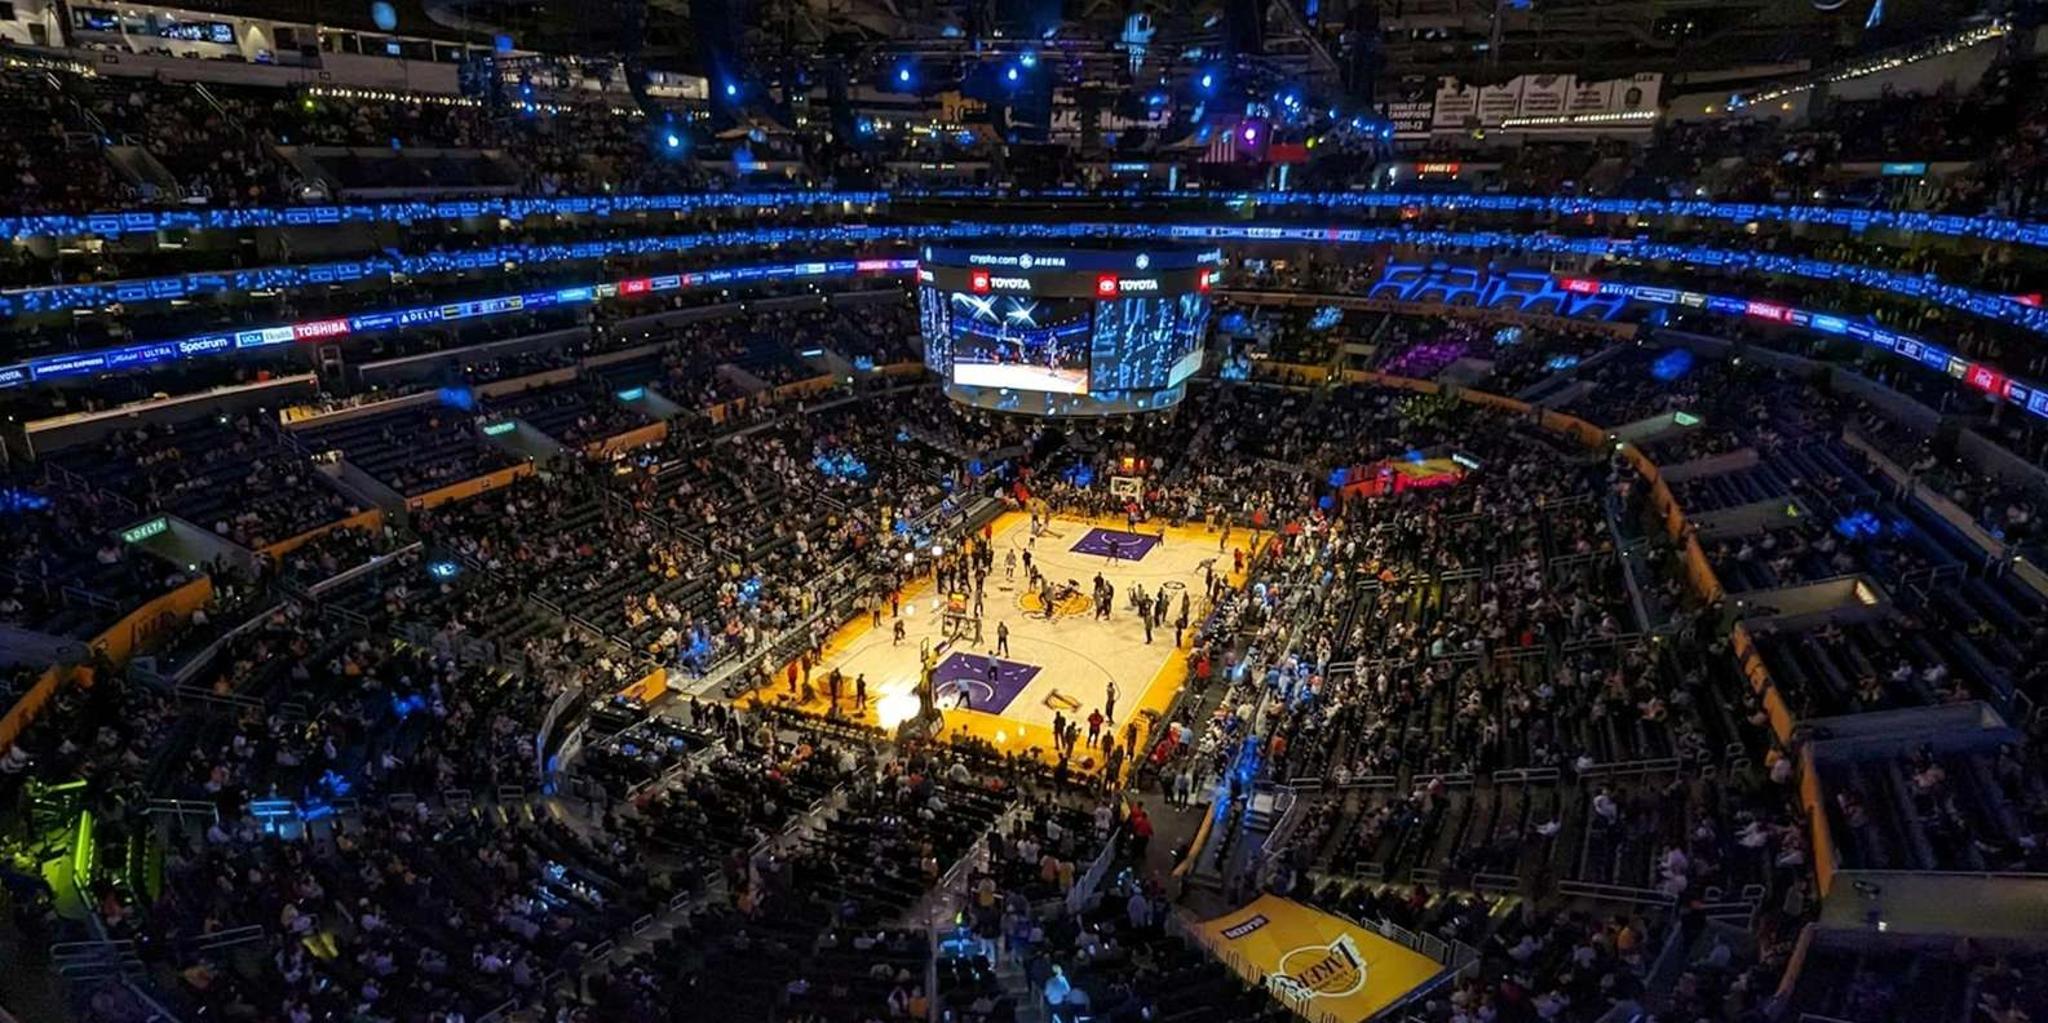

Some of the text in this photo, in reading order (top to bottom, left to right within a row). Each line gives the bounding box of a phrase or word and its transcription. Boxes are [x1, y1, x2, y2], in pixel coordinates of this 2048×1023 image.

[969, 254, 1066, 267] crypto.com ARENA
[990, 277, 1031, 290] TOYOTA
[1118, 279, 1158, 291] TOYOTA
[410, 310, 440, 321] DELTA
[242, 328, 292, 344] UCLA Health
[297, 321, 347, 337] TOSHIBA
[144, 347, 172, 359] ULTRA
[179, 338, 228, 354] Spectrum
[37, 357, 104, 374] AMERICAN EXPRESS
[133, 518, 165, 539] DELTA
